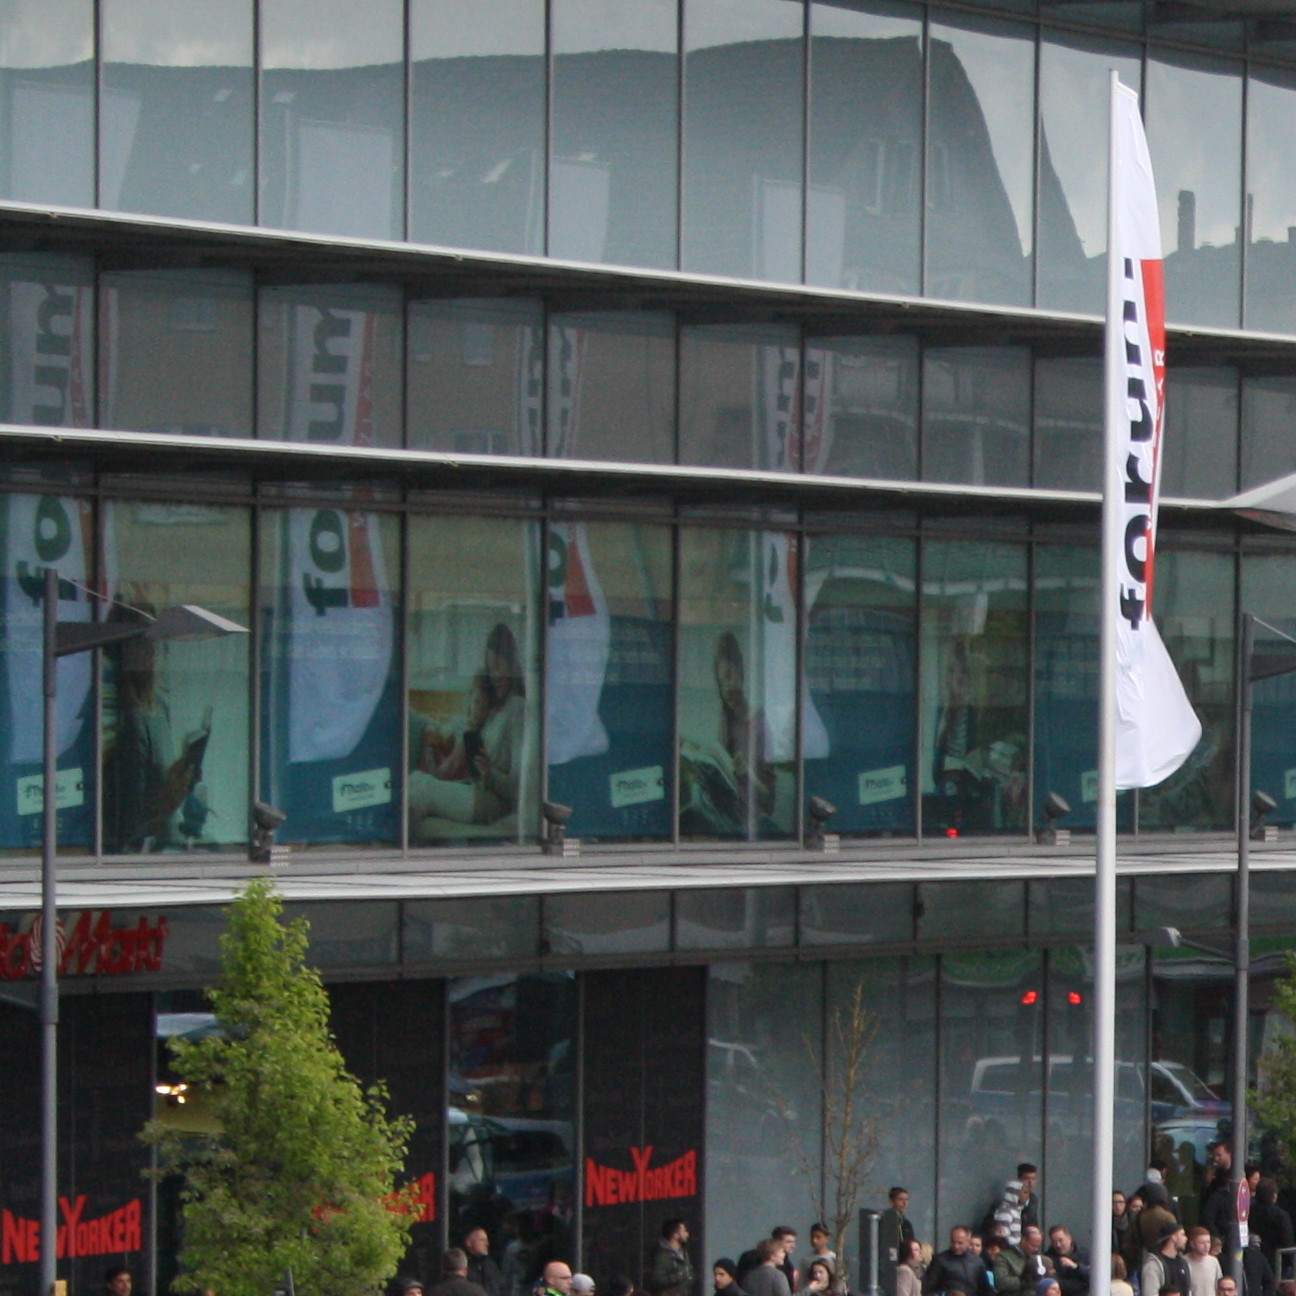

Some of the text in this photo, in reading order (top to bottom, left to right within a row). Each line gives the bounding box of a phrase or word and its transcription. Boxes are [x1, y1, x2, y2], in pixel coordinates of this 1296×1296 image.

[1099, 257, 1153, 631] forum
[586, 1145, 697, 1207] NEW YORKER
